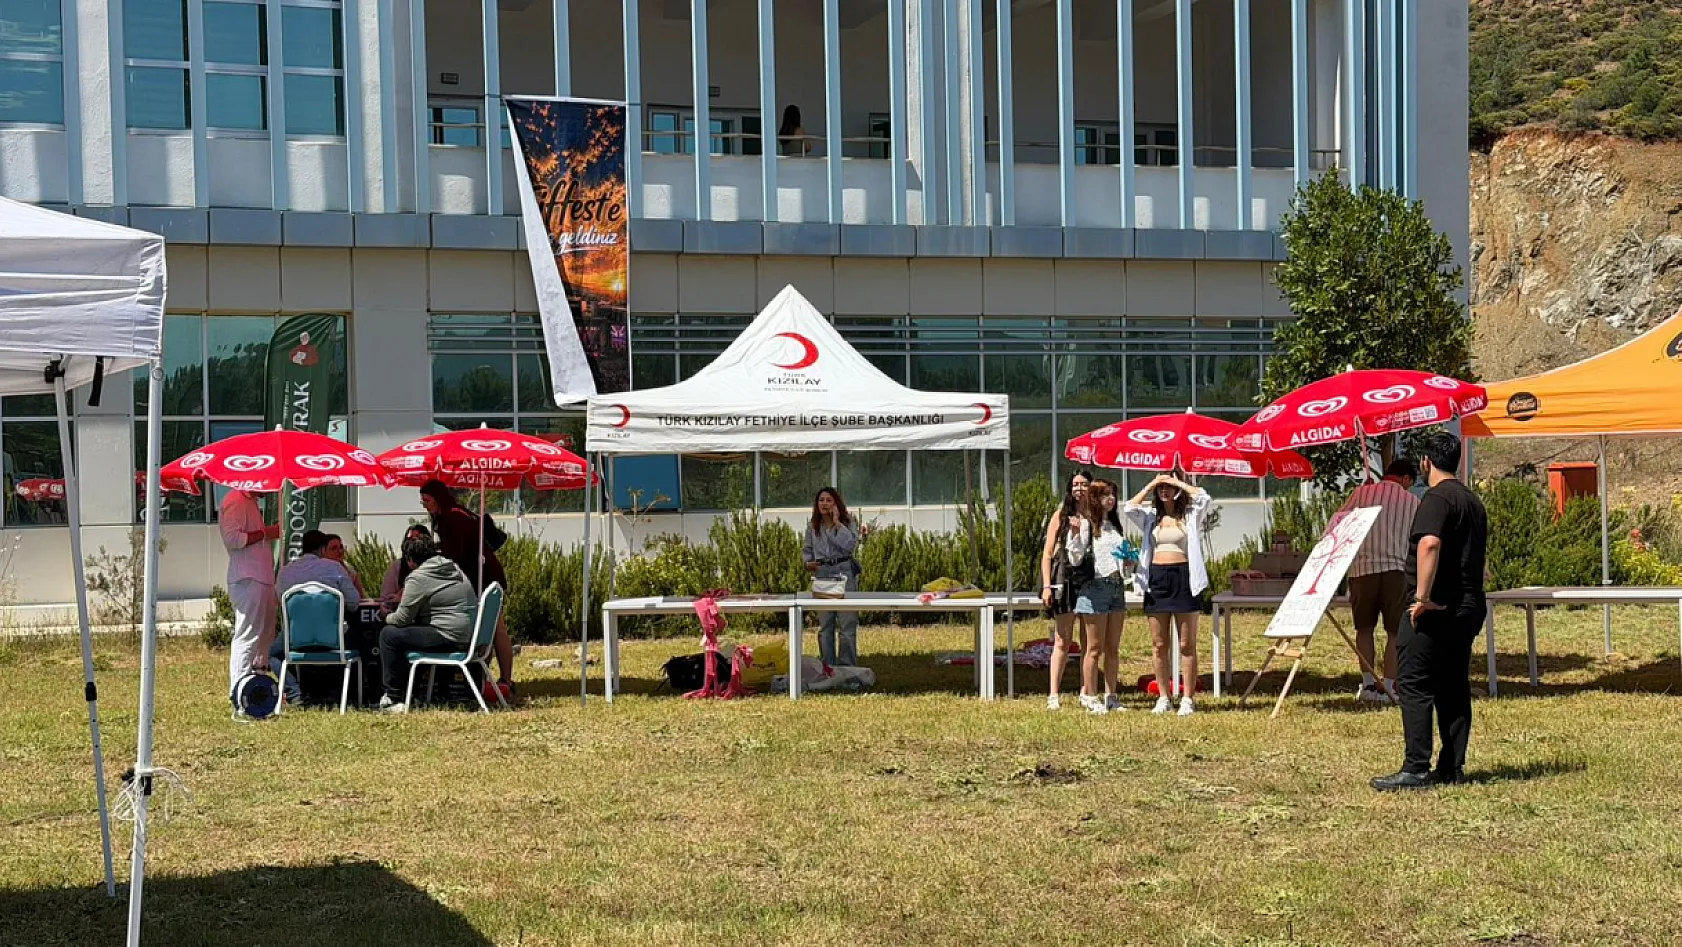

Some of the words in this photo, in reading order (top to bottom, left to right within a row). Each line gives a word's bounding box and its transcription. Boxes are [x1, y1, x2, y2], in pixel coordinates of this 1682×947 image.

[557, 225, 619, 254] geldiniz
[657, 414, 691, 426] TÜRK
[694, 415, 742, 427] KIZILAY
[745, 413, 797, 426] FETHİYE
[800, 413, 827, 428] İLÇE
[831, 415, 866, 428] ŞUBE
[868, 413, 944, 427] BAŞKANLIĞI
[286, 487, 307, 562] RDOĞA
